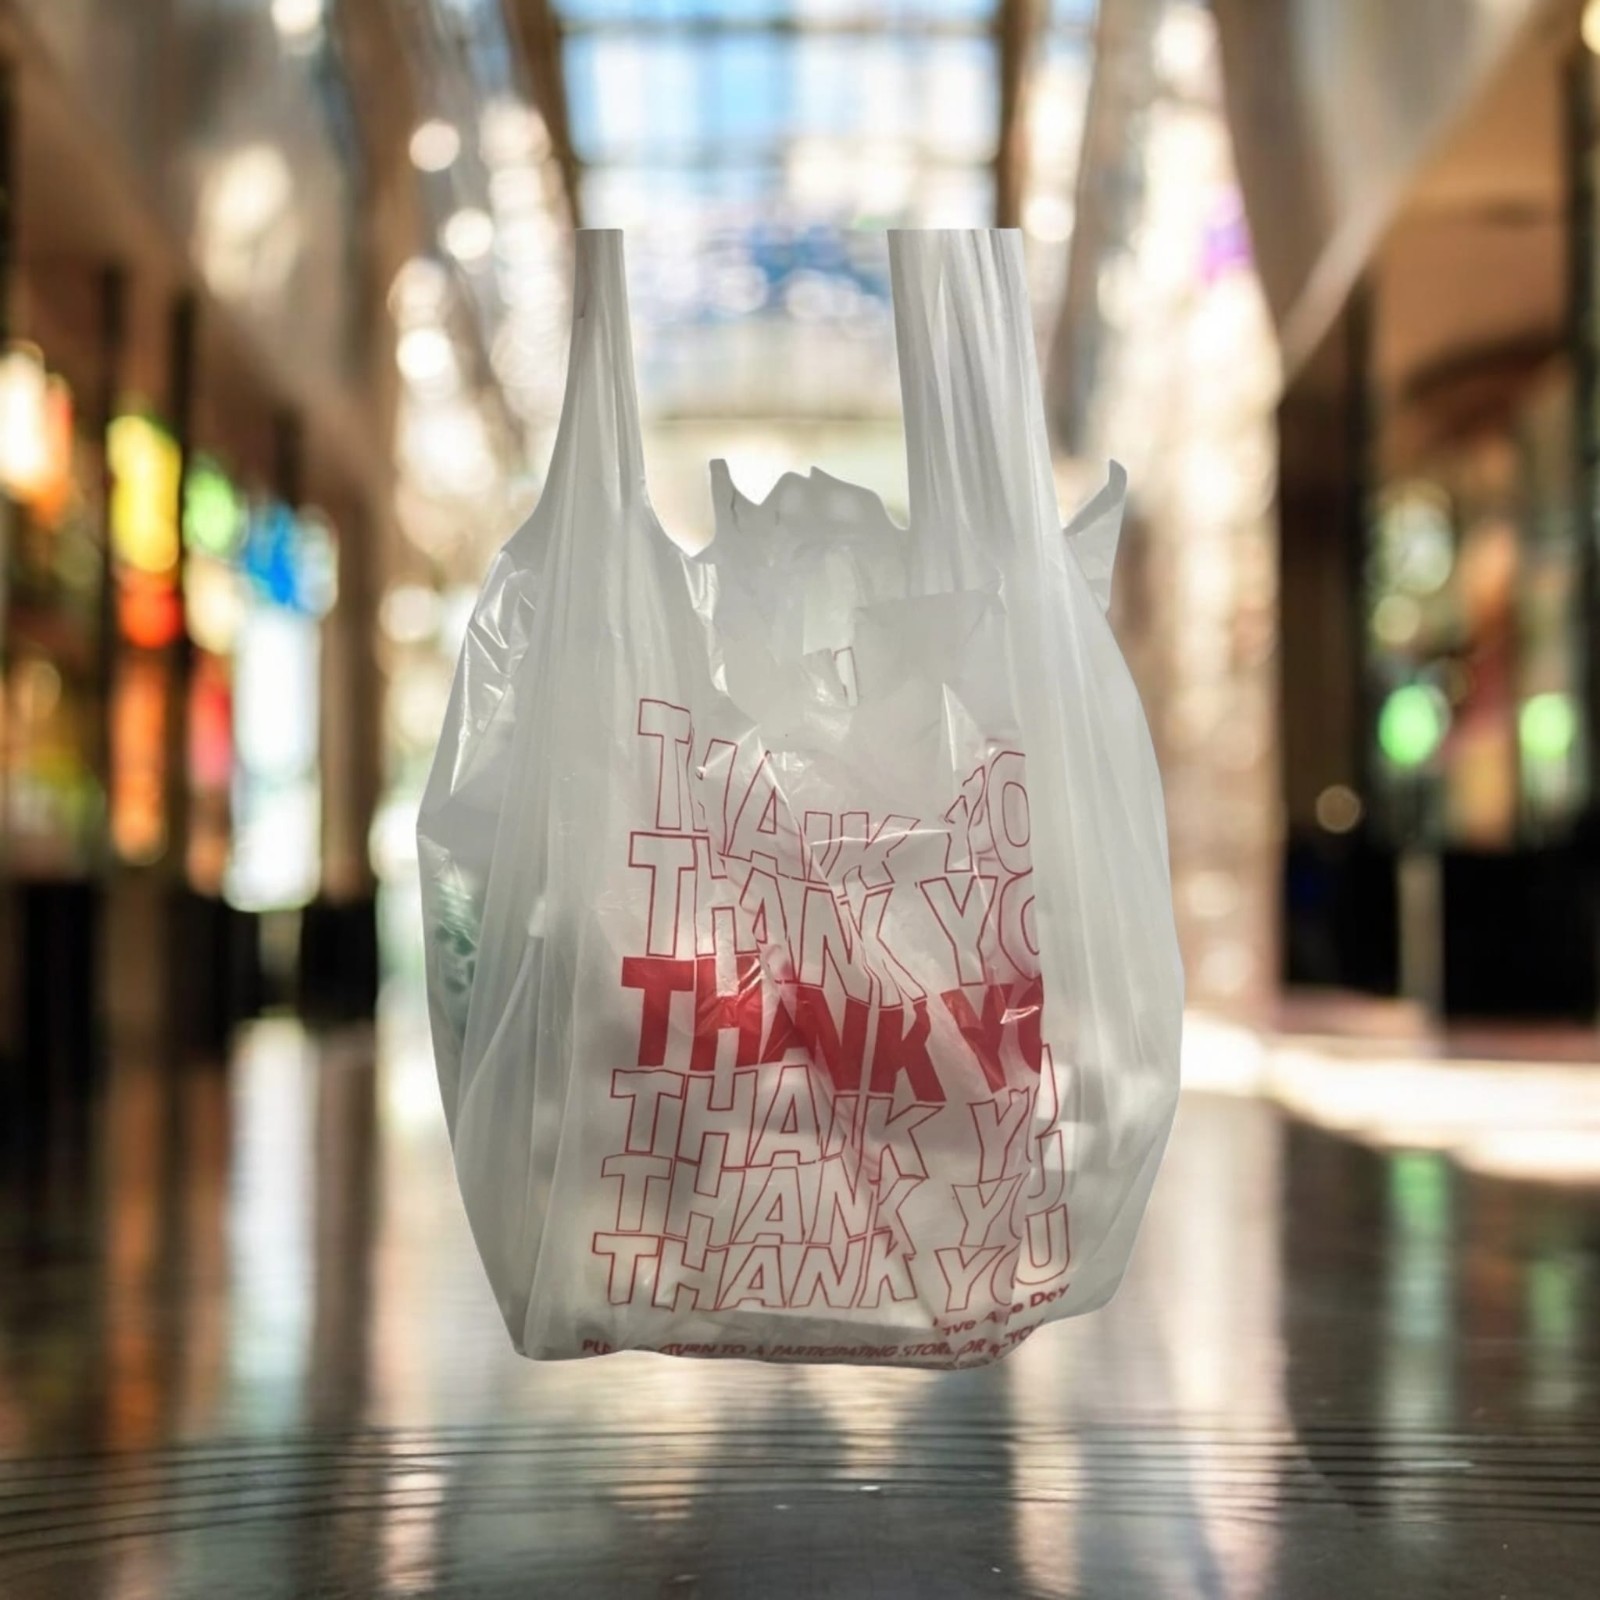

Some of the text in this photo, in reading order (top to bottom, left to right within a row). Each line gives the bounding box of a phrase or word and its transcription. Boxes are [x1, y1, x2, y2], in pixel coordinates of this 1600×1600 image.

[628, 831, 927, 1009] THANK
[621, 956, 947, 1103] THANK
[611, 1065, 945, 1180] THANK
[602, 1152, 926, 1256] THANK
[593, 1229, 918, 1313] THANK
[722, 1343, 746, 1355] TO
[771, 1344, 898, 1358] PARTICIPATING
